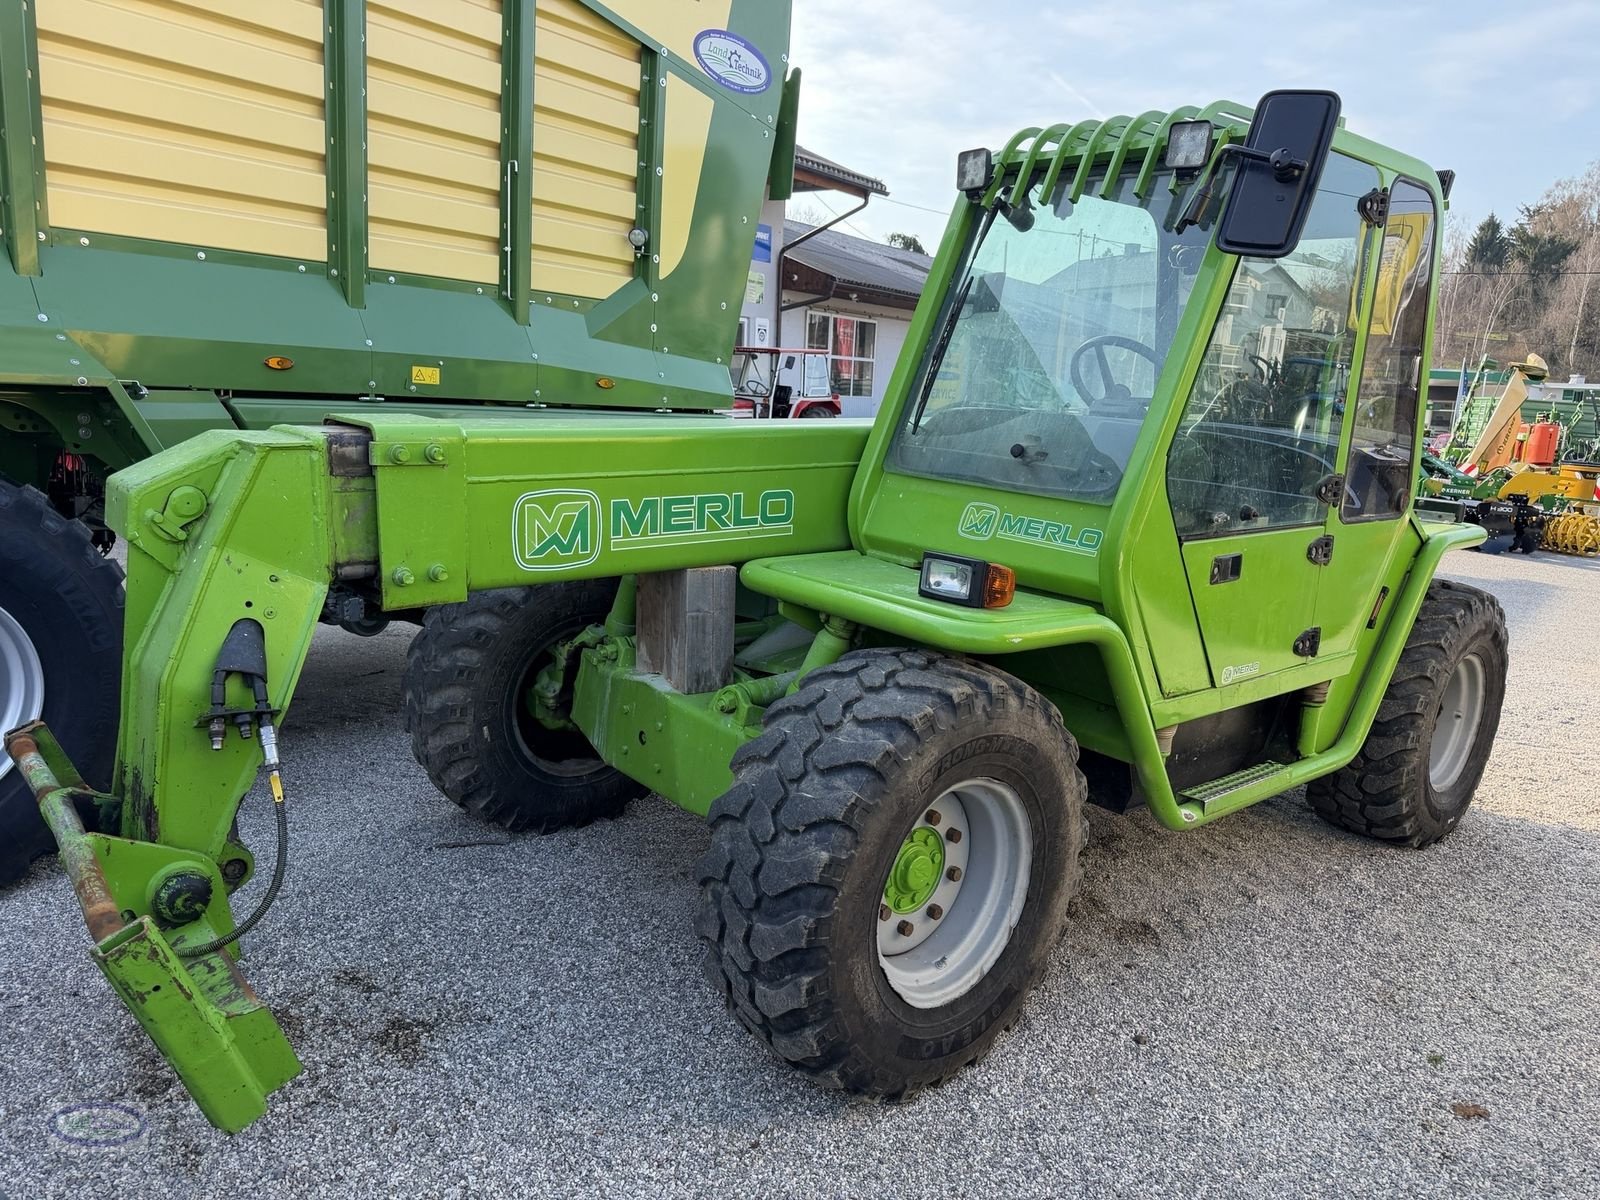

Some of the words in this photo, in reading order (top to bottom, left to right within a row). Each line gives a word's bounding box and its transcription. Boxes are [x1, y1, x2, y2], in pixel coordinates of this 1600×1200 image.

[708, 41, 729, 59] Land
[734, 59, 762, 80] Technik
[930, 388, 956, 400] ERVICE
[610, 489, 794, 539] MERLO
[1000, 513, 1104, 550] MERLO
[1233, 661, 1260, 676] MERLO
